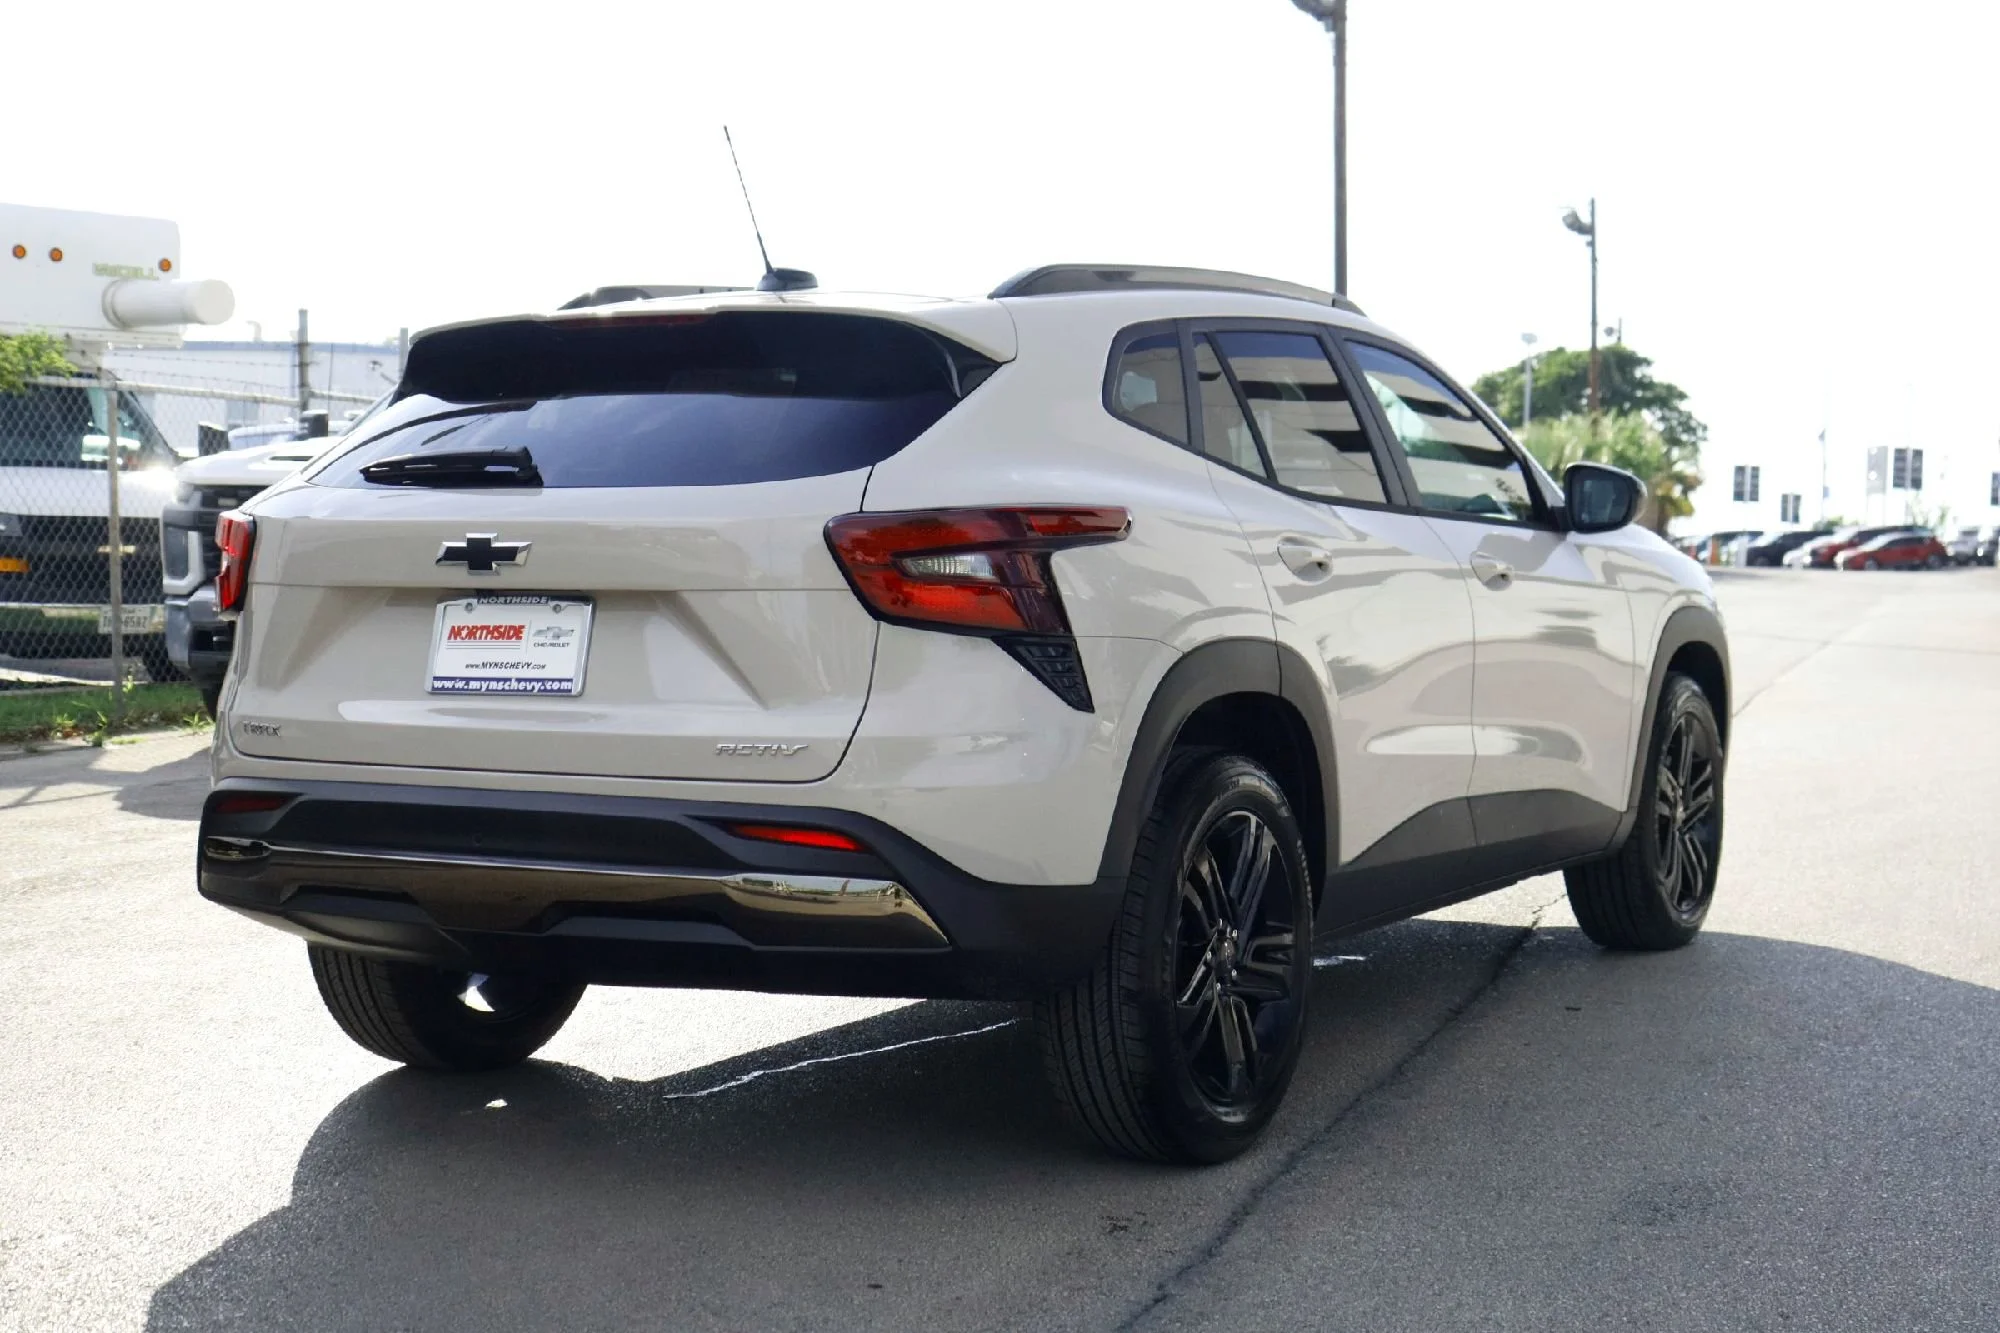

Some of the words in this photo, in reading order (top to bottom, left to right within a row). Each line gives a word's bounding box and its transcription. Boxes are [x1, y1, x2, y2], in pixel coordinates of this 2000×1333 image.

[479, 596, 549, 605] NORTHSIDE
[447, 624, 526, 641] NORTHSIDE
[432, 678, 572, 692] www.mynschevy.com
[716, 743, 809, 756] ACTIV
